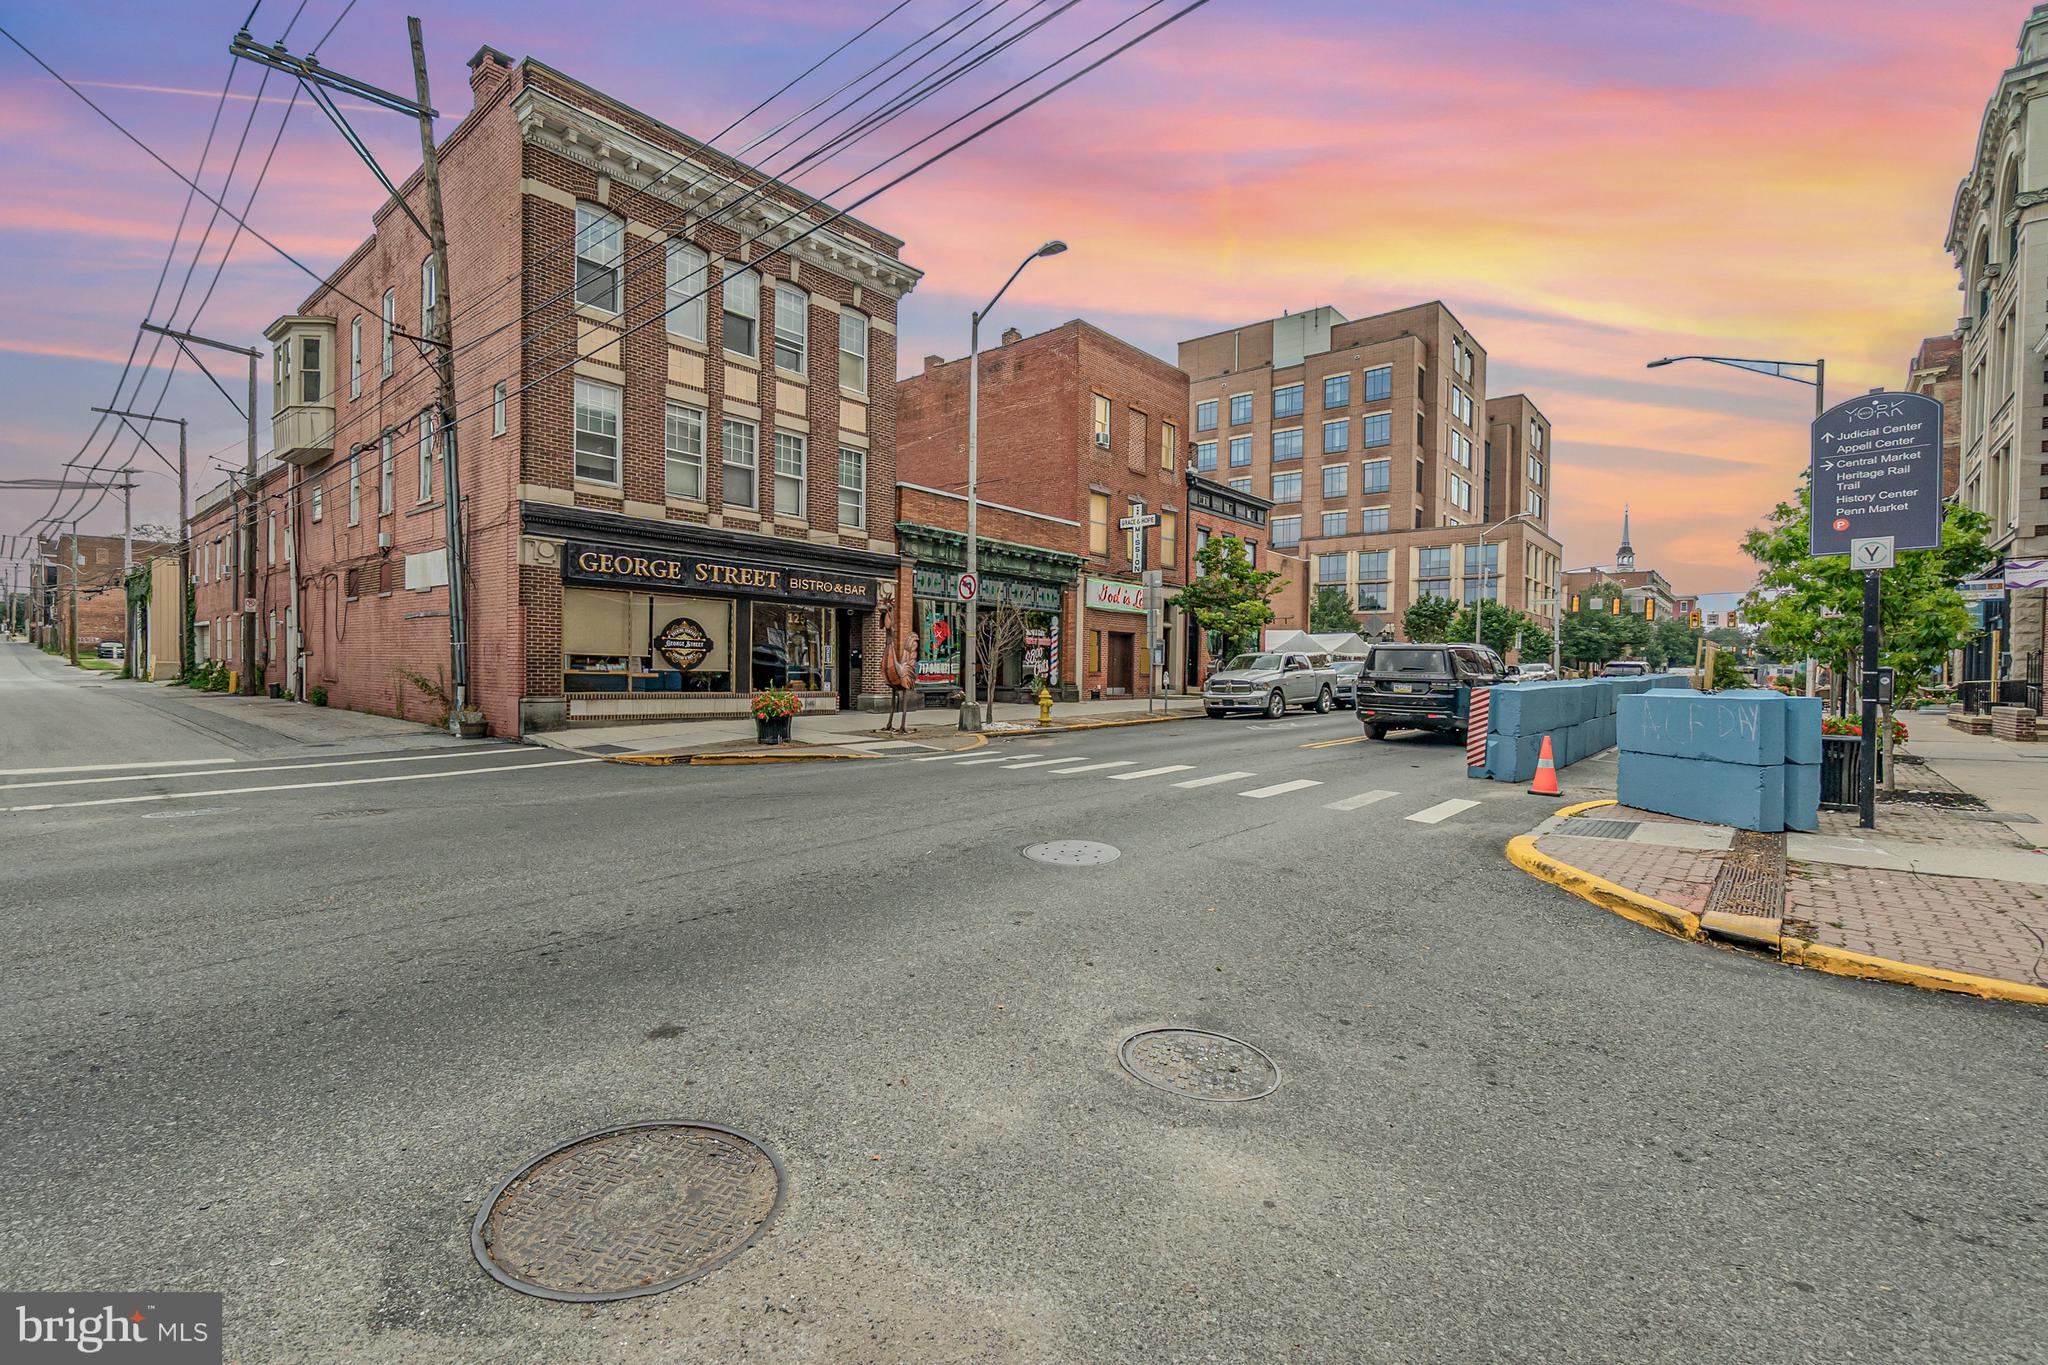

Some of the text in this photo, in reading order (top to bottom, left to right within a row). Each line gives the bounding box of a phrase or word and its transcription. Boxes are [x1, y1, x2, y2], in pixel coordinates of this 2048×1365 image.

[1845, 399, 1906, 423] YORK
[1836, 421, 1923, 441] Judicial Center
[1836, 436, 1916, 454] Appell Center
[1836, 451, 1922, 469] Central Market
[1836, 465, 1911, 481] Heritage Rail
[1836, 481, 1861, 492] Trail
[1836, 488, 1919, 504] History Center
[1836, 502, 1909, 517] Penn Market
[1141, 516, 1154, 524] HOPE
[578, 552, 681, 580] GEORGE
[695, 563, 781, 589] STREET
[1098, 584, 1121, 604] God
[1123, 590, 1131, 606] is
